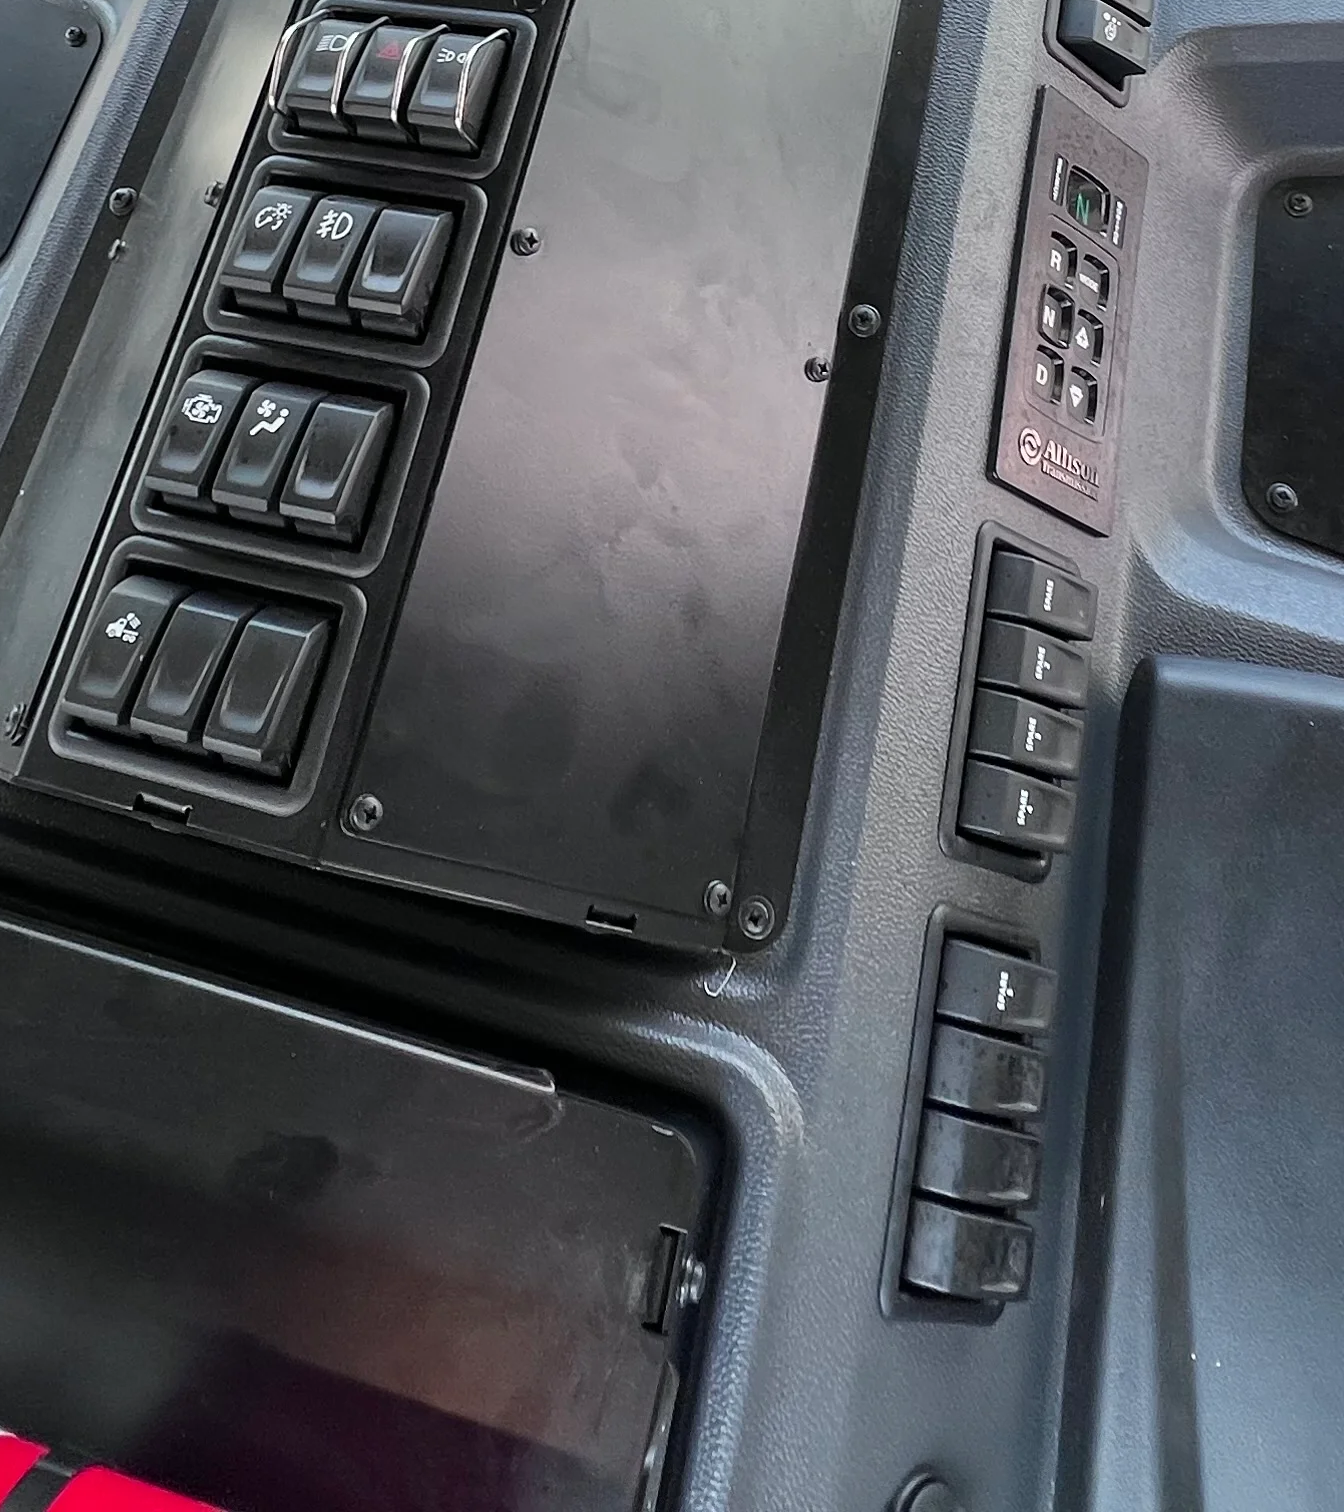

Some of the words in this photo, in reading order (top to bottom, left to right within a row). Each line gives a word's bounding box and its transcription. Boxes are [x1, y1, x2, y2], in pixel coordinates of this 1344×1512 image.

[1075, 193, 1089, 227] N
[1049, 249, 1062, 272] R
[1042, 305, 1056, 328] N
[1036, 363, 1048, 386] D
[1042, 440, 1099, 488] Allison
[1044, 579, 1055, 612] SPARE
[1034, 646, 1046, 680] SPARE
[1025, 717, 1037, 751] SPARE
[1017, 789, 1029, 826] SPARE
